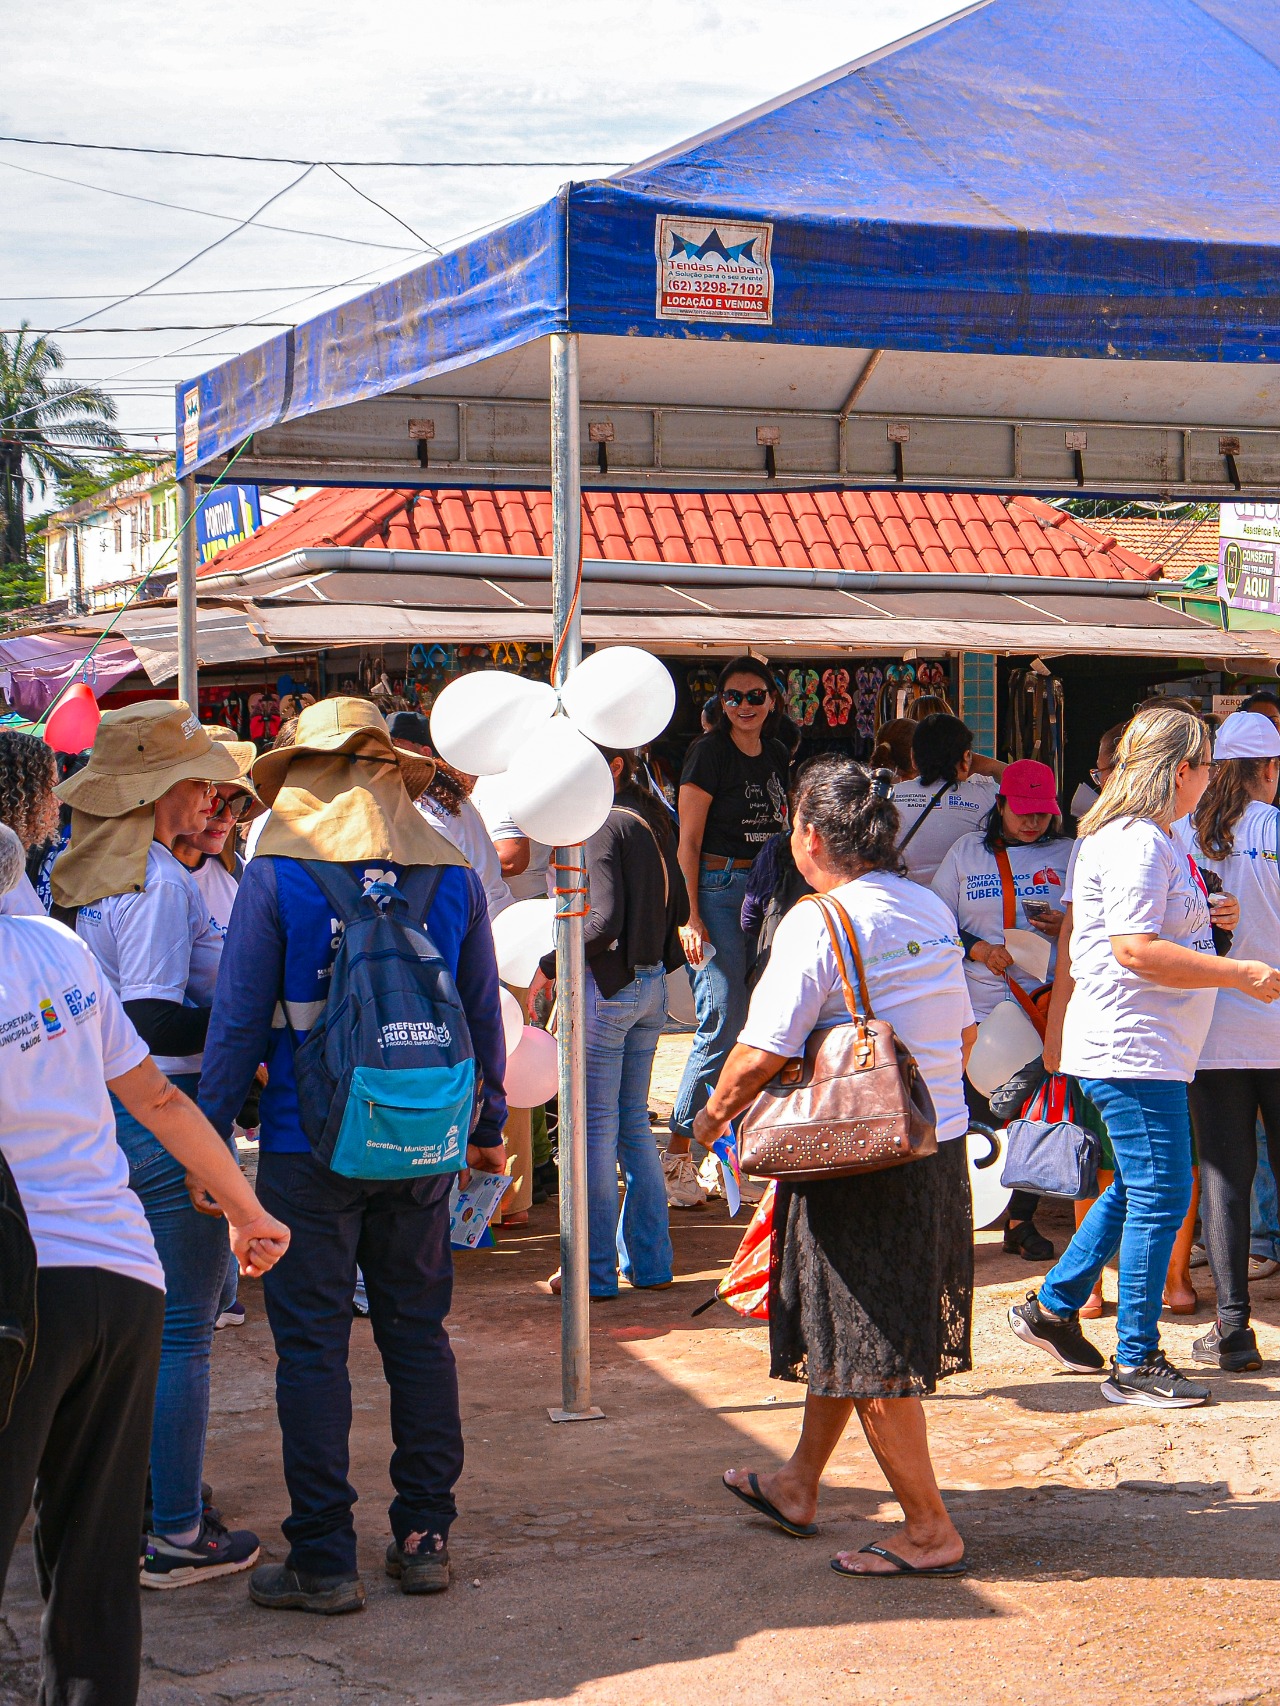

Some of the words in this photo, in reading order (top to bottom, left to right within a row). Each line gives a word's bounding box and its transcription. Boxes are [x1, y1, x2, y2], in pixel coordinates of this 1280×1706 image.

[669, 260, 713, 271] Tendas
[717, 264, 763, 275] Aluban
[668, 280, 691, 292] (62)
[694, 281, 763, 295] 3298-7102
[666, 295, 713, 309] LOCAÇÃO
[716, 300, 722, 308] E
[725, 300, 763, 309] VENDAS
[1243, 549, 1274, 564] CONSERTE
[1243, 576, 1270, 598] AQUI
[949, 800, 980, 809] BRANCO
[966, 874, 996, 883] JUNTOS
[64, 988, 83, 1006] RIO
[30, 1020, 40, 1032] DE
[20, 1034, 42, 1052] SAÚDE
[384, 1030, 409, 1043] RIO
[366, 1139, 402, 1152] Secretaria
[404, 1144, 436, 1153] Municipal
